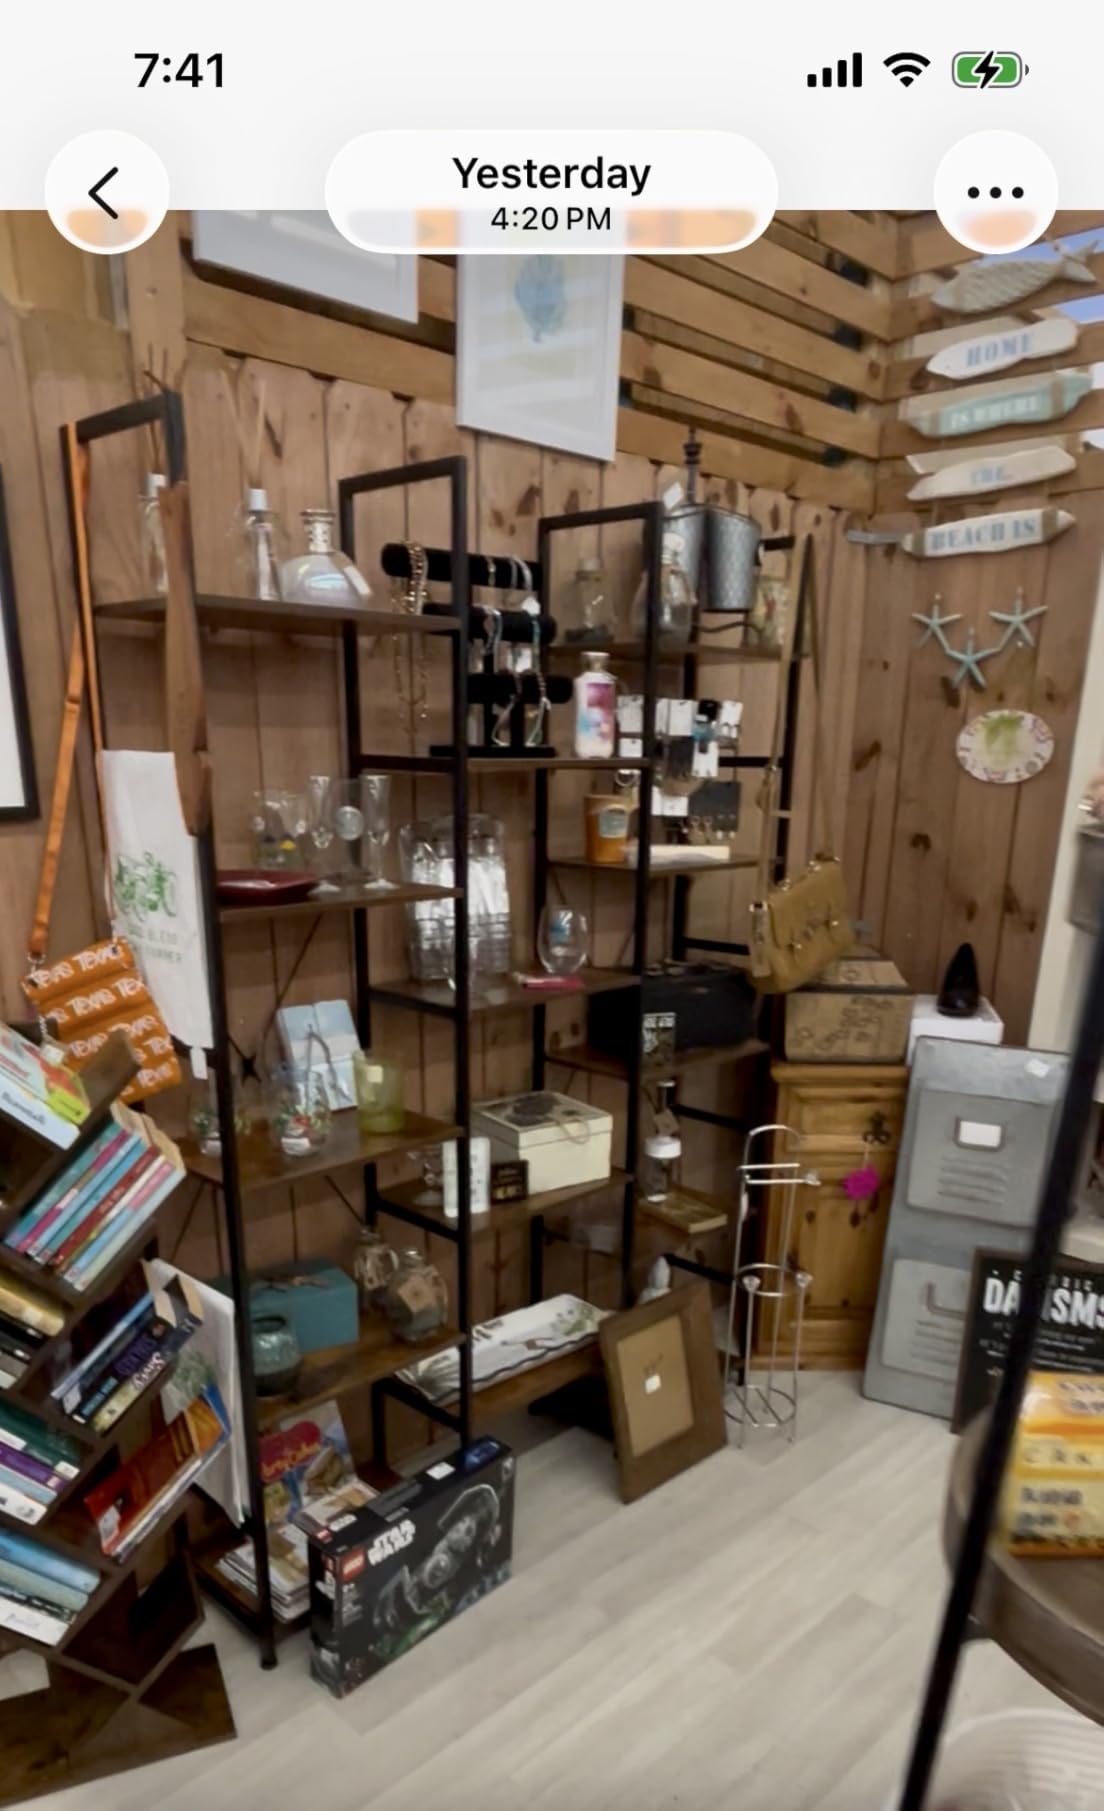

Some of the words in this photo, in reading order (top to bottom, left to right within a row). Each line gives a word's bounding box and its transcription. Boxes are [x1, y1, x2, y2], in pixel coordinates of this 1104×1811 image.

[966, 333, 1034, 368] HOME
[931, 522, 1005, 551] BEACH
[1012, 517, 1036, 541] IS
